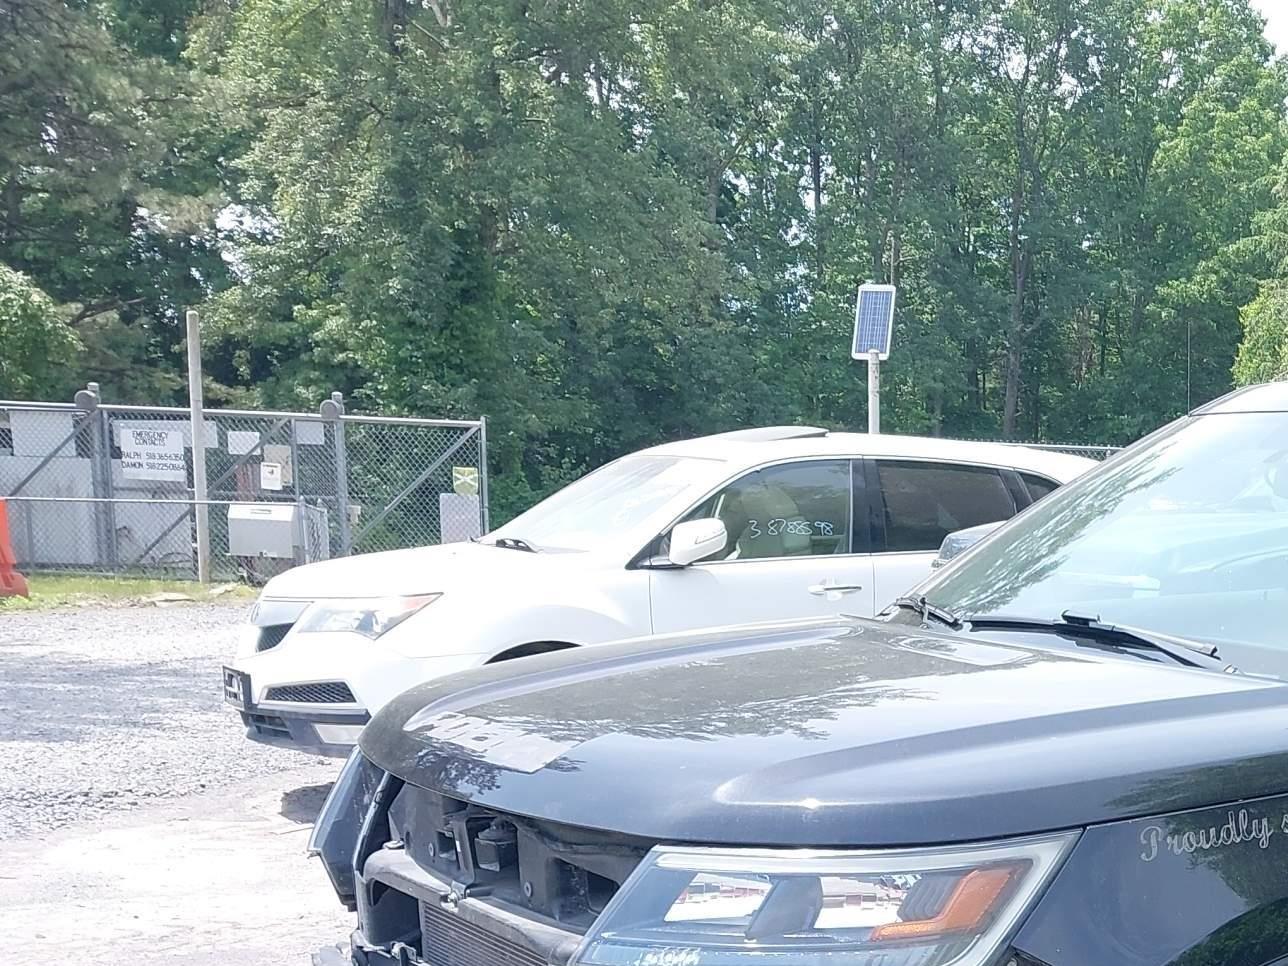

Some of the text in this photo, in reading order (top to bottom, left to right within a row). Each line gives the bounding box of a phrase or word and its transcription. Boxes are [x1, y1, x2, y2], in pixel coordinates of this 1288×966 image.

[131, 430, 169, 439] EMERGENCY
[134, 438, 166, 446] CONTACTS
[121, 450, 142, 459] RALPH
[121, 460, 144, 469] DAMON
[1139, 808, 1274, 862] Proudly
